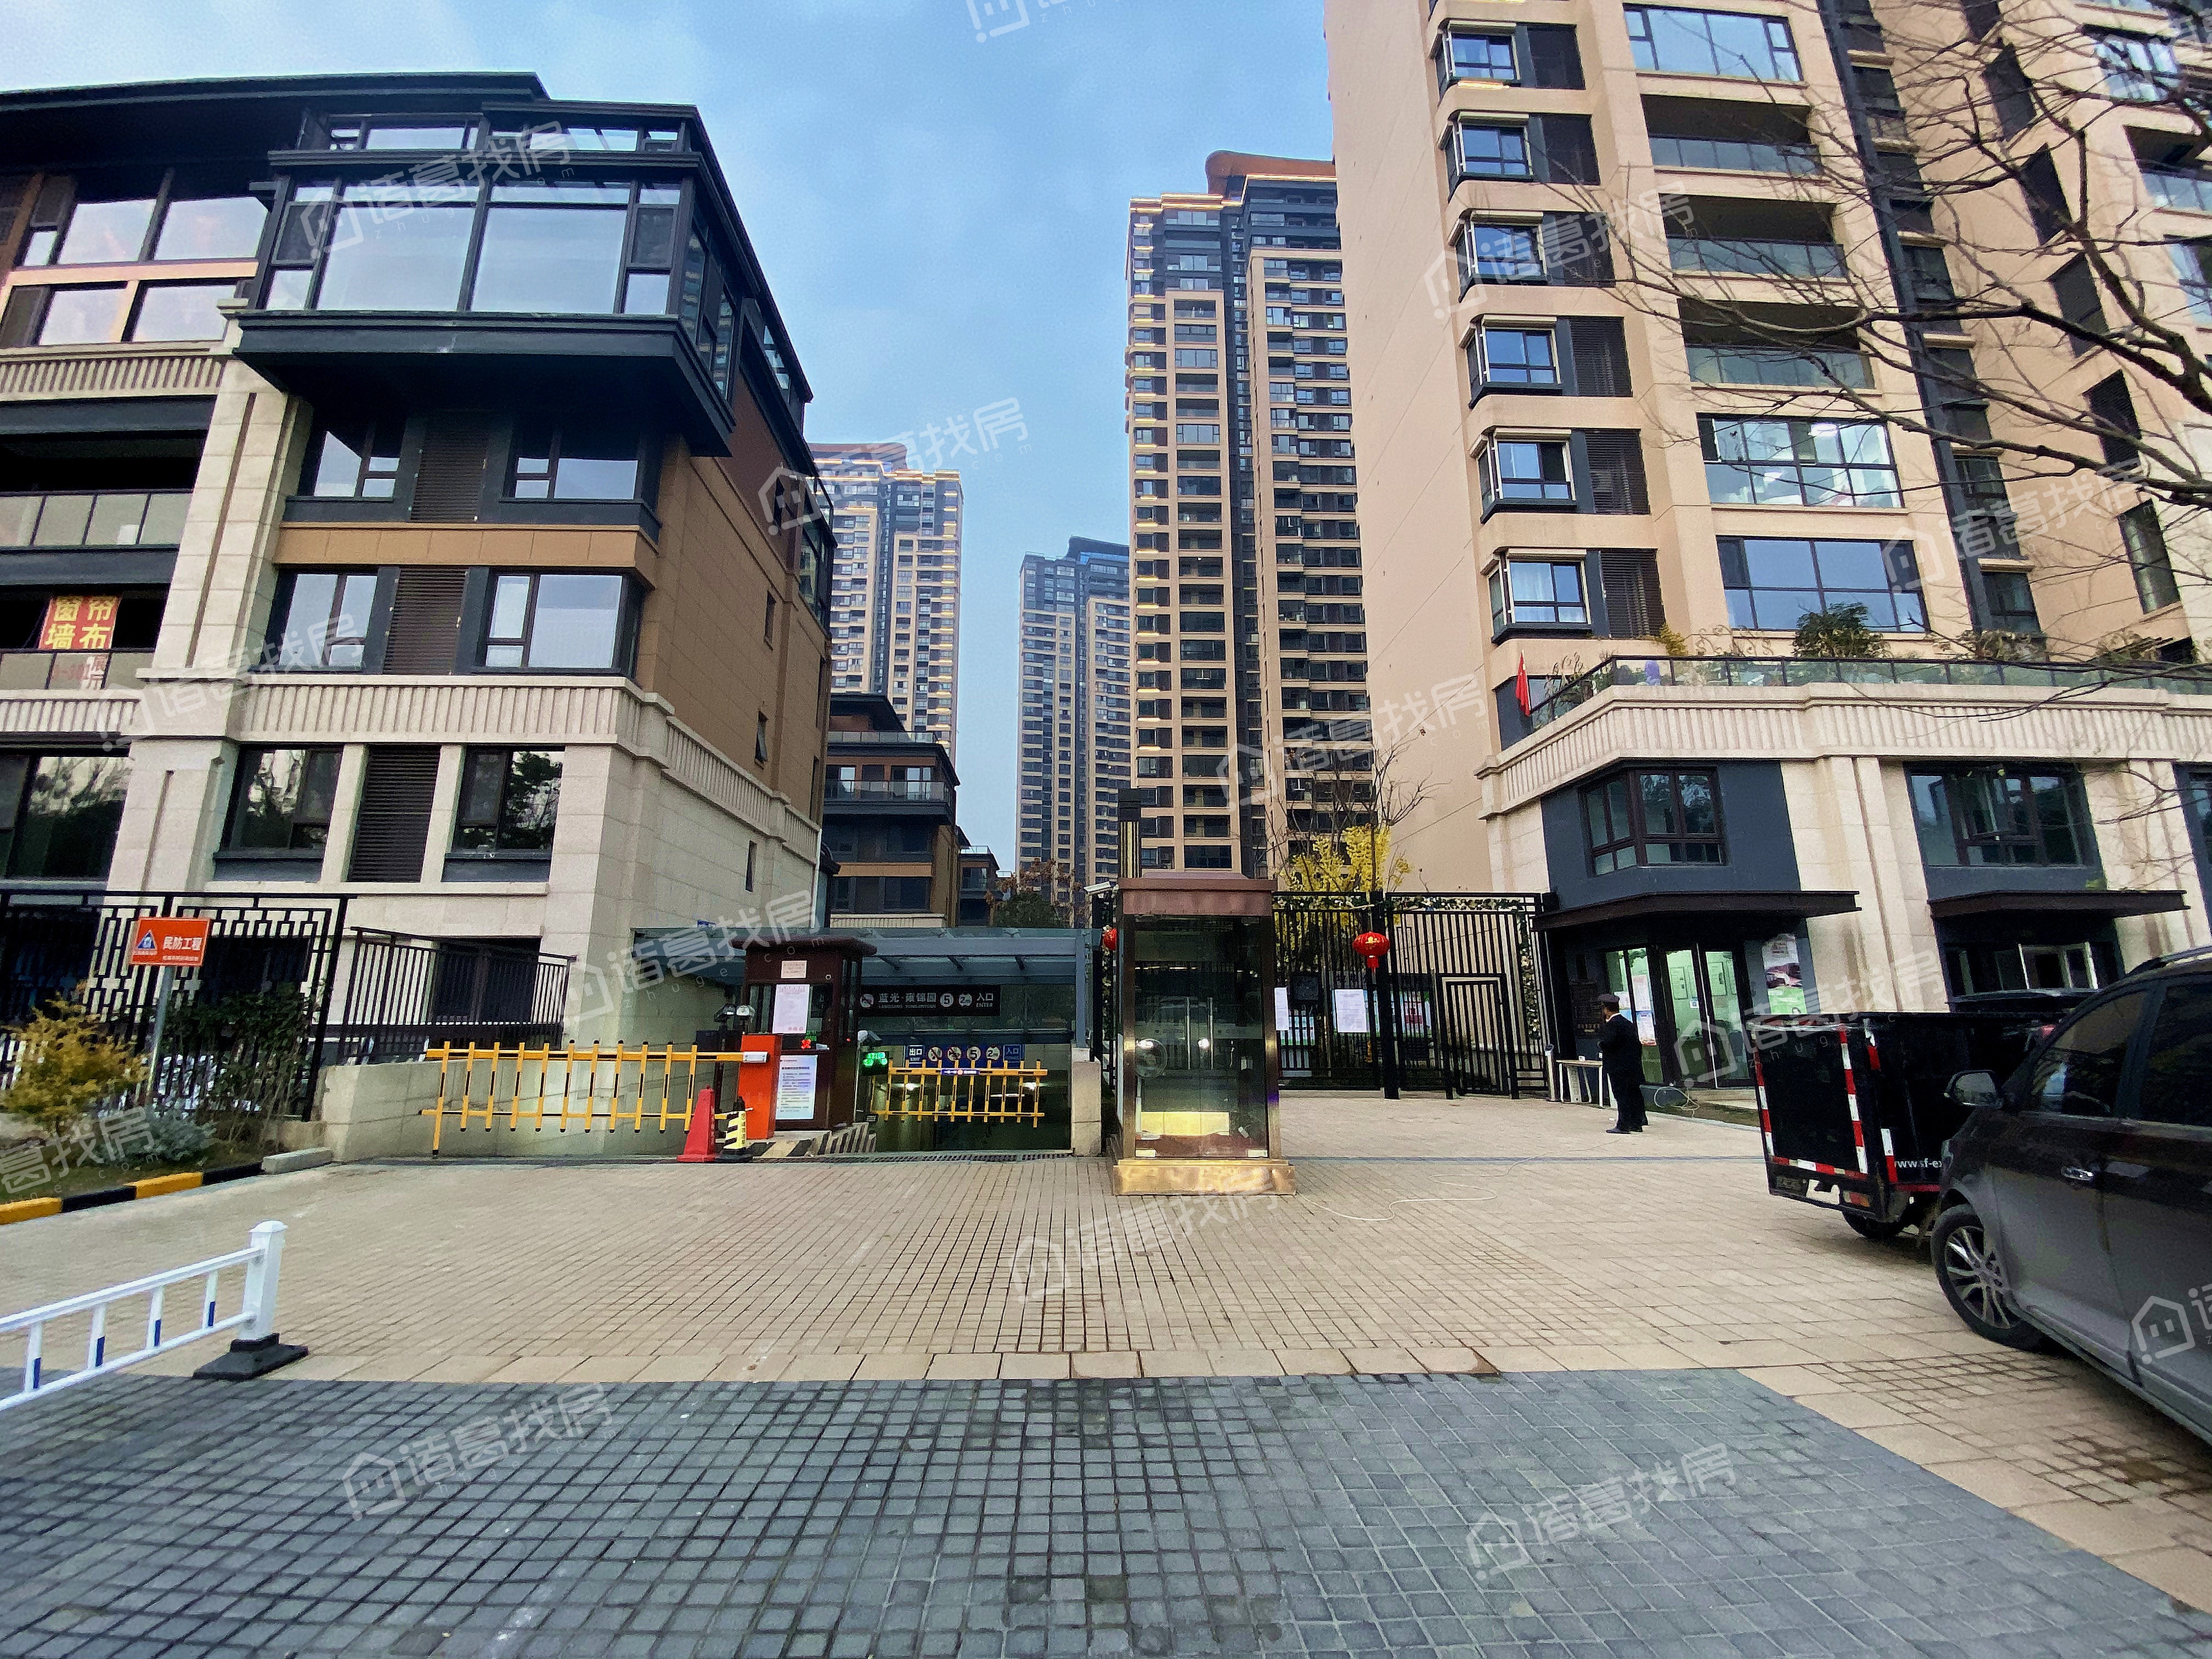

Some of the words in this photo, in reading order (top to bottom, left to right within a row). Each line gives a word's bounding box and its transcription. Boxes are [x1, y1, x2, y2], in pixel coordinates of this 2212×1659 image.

[44, 623, 112, 648] 墙布
[977, 992, 994, 1002] 入口
[909, 1048, 922, 1056] 出口
